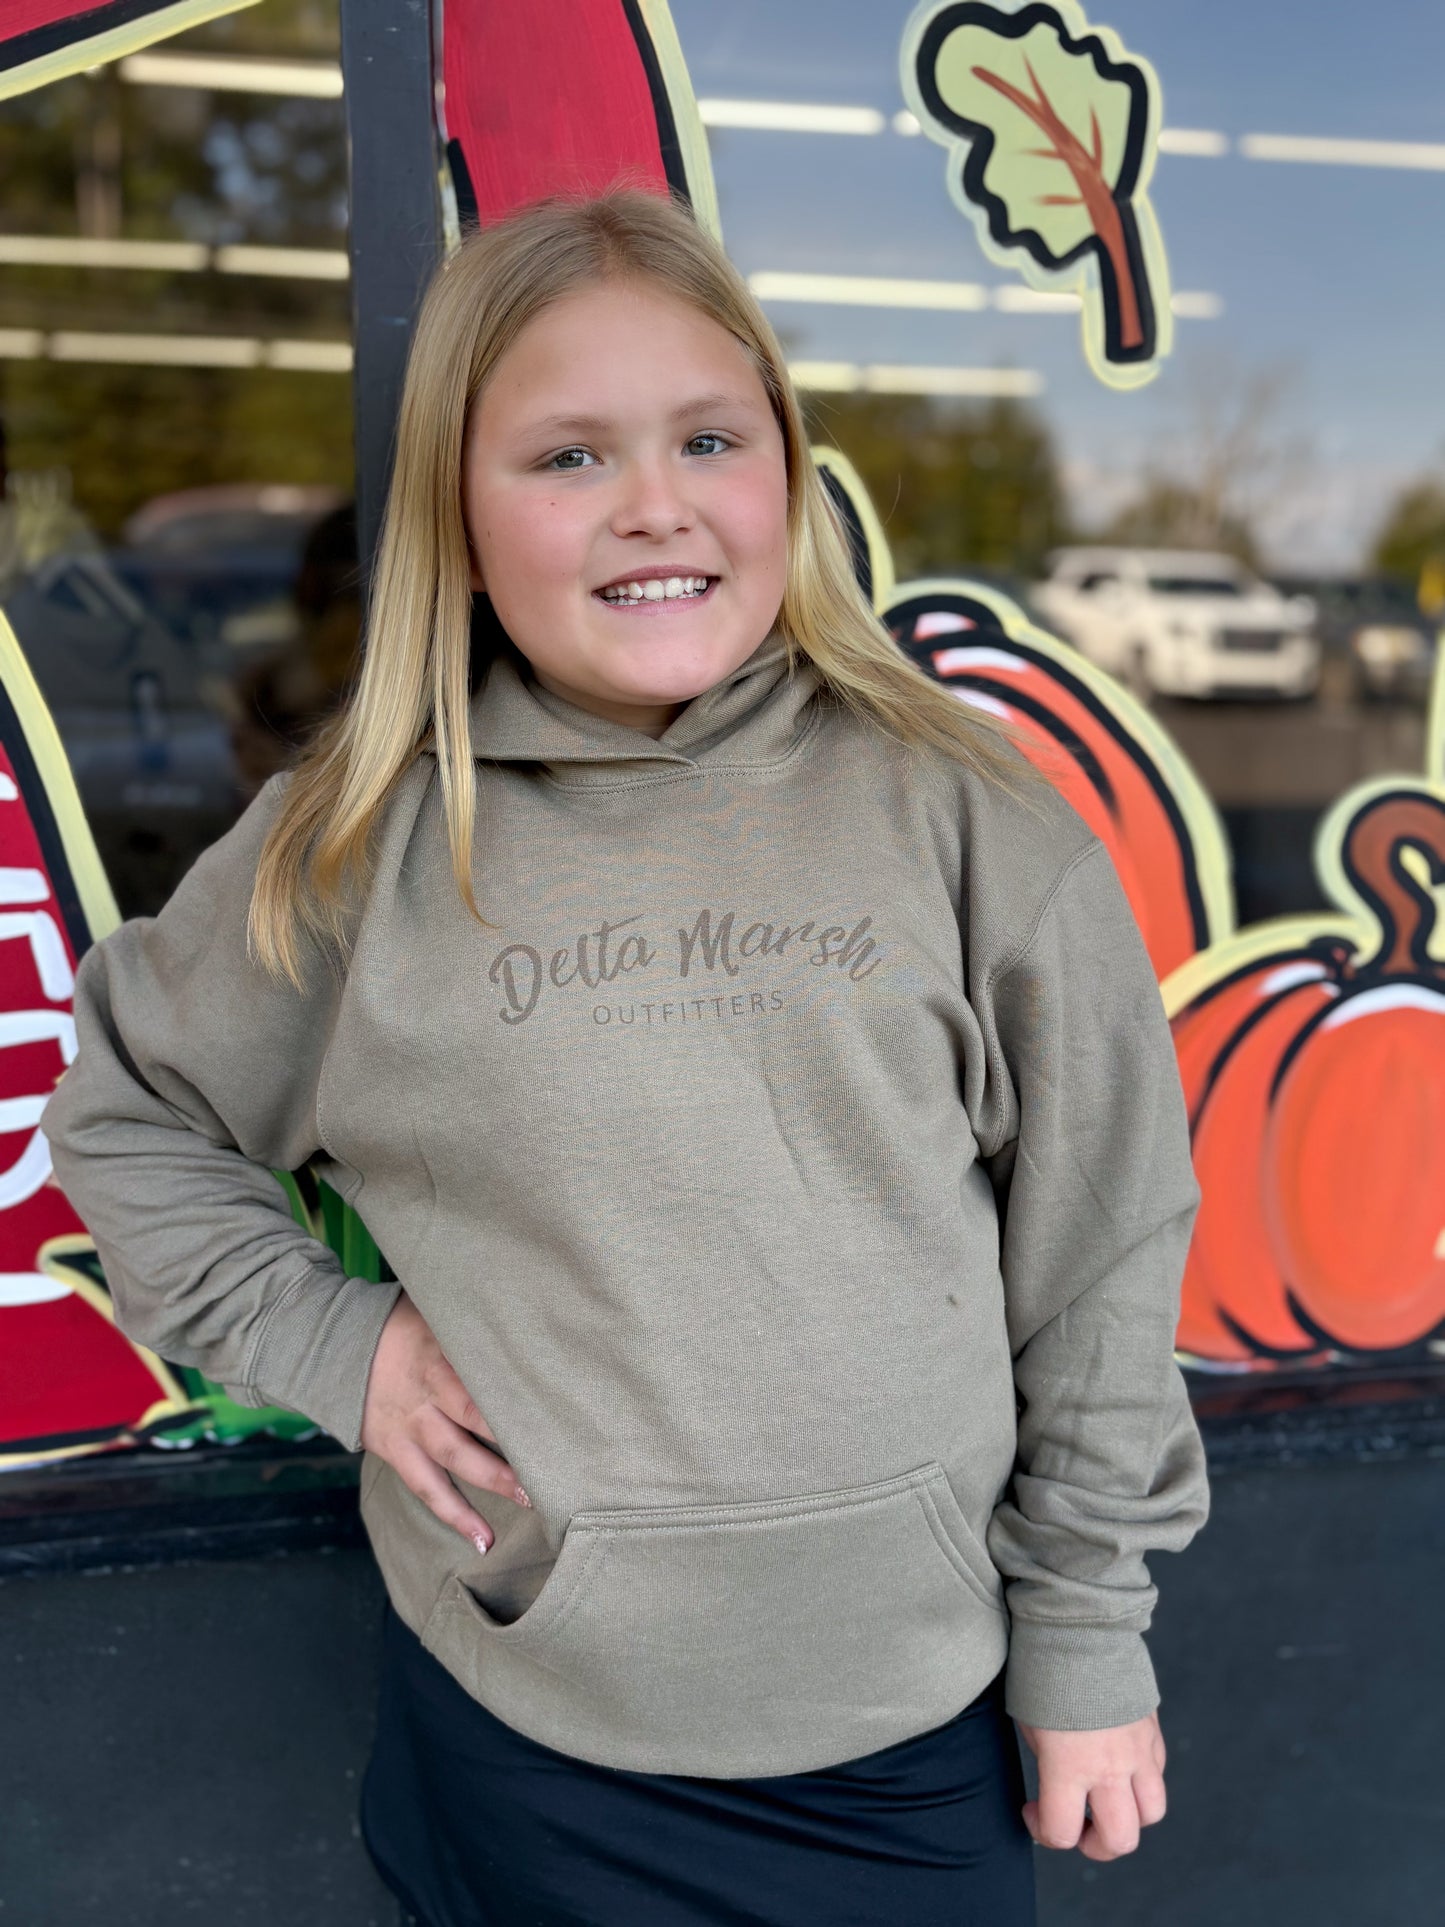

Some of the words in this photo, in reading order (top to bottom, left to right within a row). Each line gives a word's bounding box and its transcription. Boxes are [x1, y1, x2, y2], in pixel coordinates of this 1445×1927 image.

[489, 913, 656, 1025] Delta
[677, 909, 882, 982] Marsh
[593, 990, 784, 1026] OUTFITTERS
